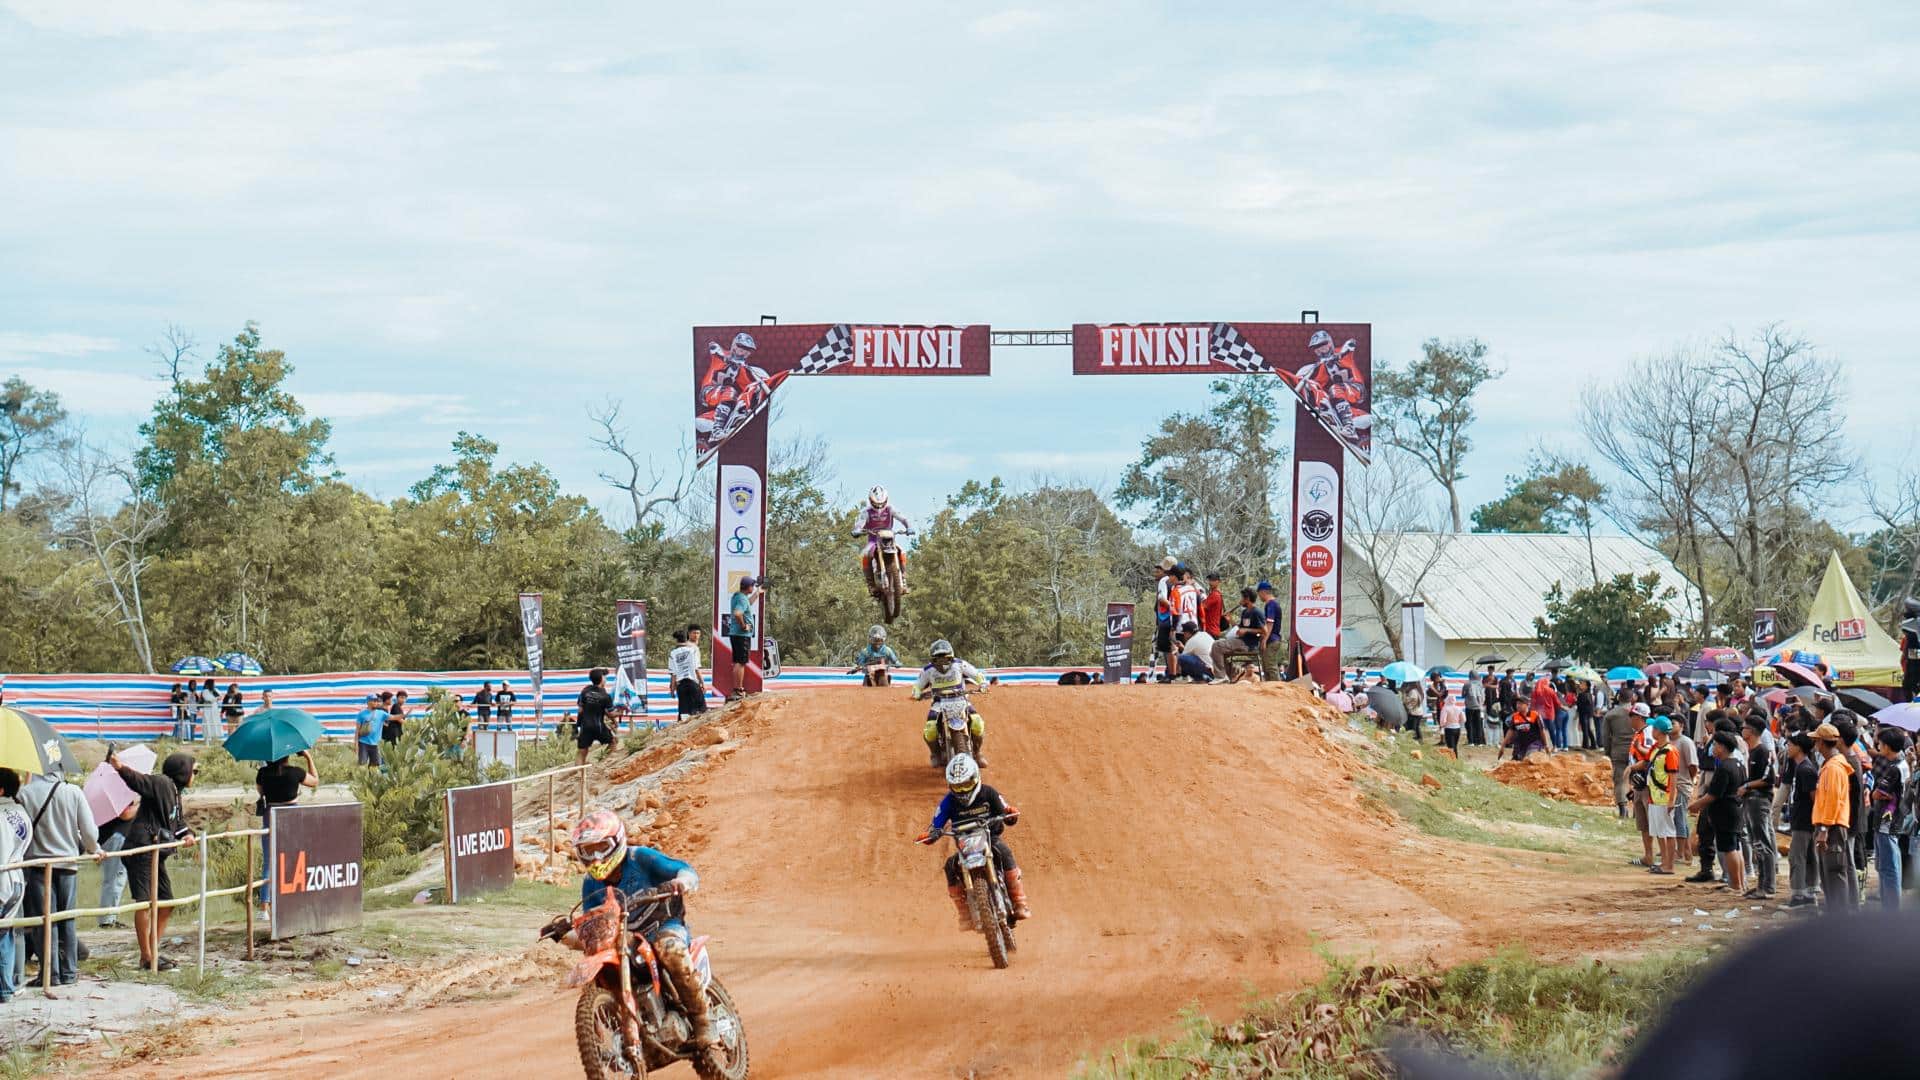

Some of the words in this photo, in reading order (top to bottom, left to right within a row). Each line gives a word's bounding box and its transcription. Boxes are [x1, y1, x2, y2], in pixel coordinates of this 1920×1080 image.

[853, 329, 962, 368] FINISH
[1100, 327, 1210, 366] FINISH
[621, 614, 642, 634] LA
[1110, 616, 1130, 634] LA
[1758, 622, 1773, 638] LA
[457, 833, 478, 857] LIVE
[480, 828, 505, 853] BOLD
